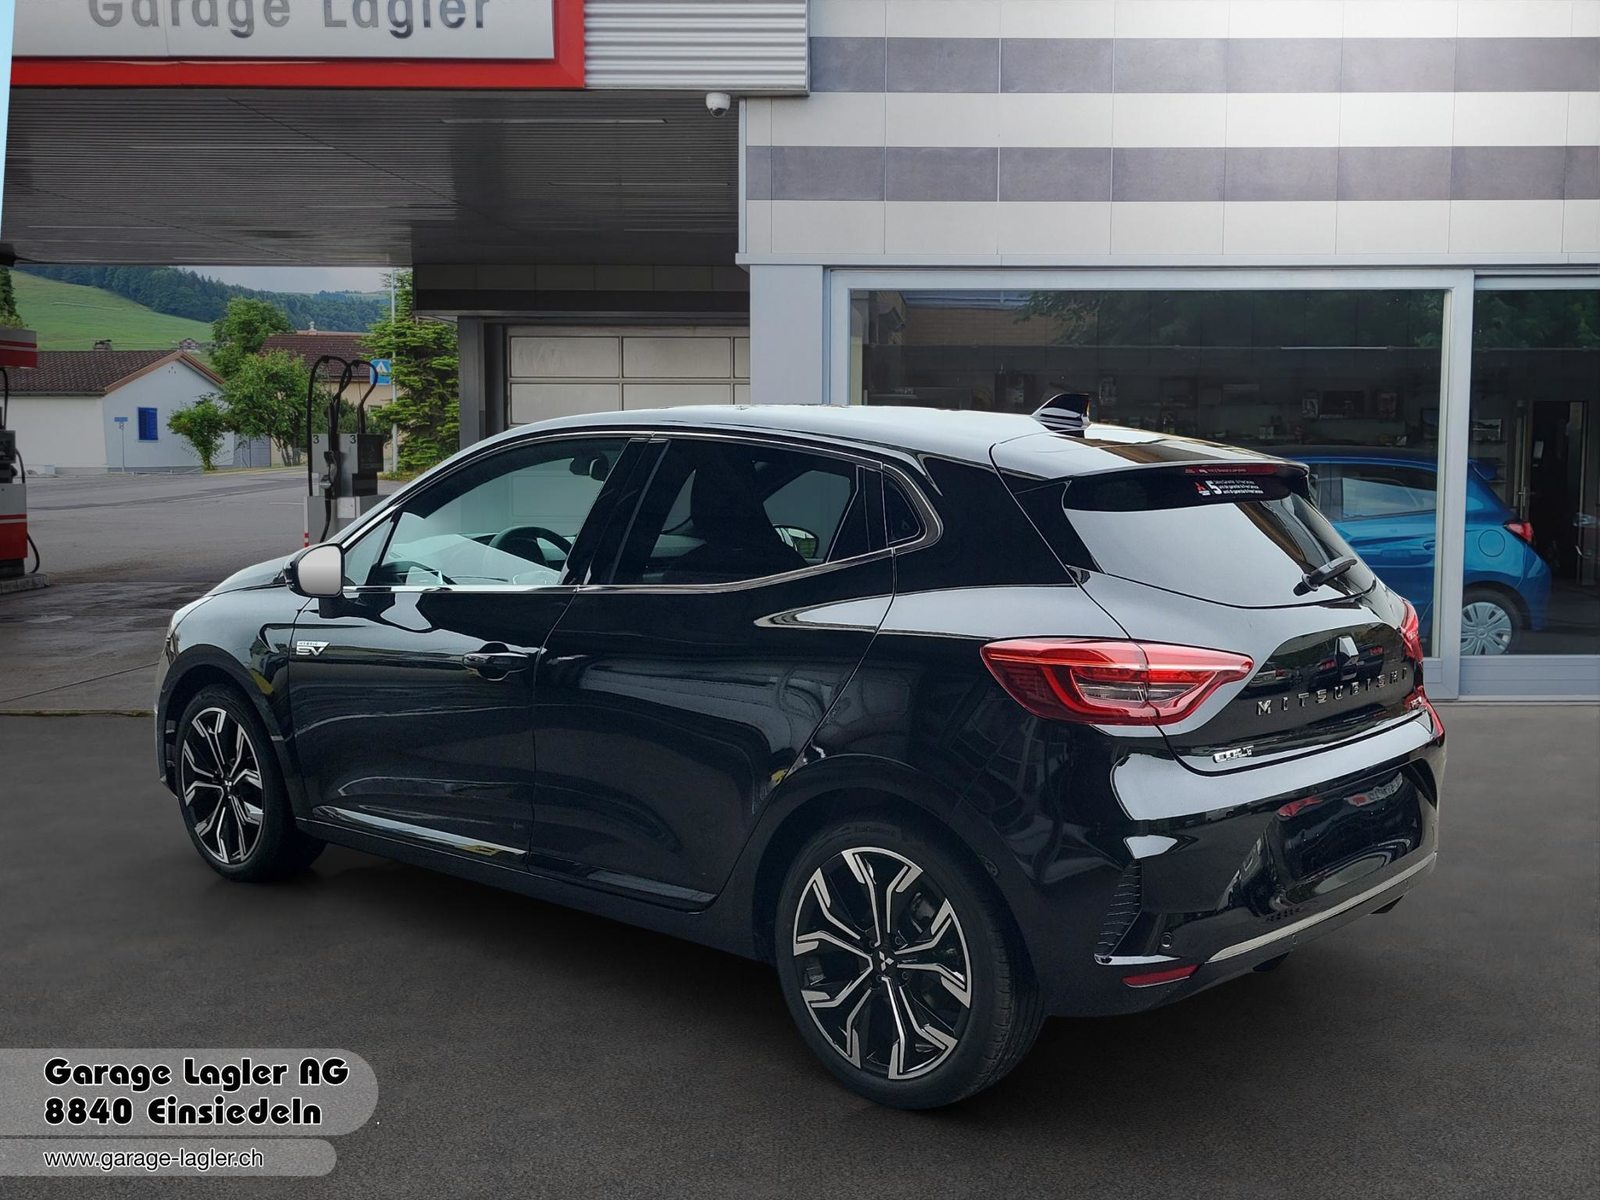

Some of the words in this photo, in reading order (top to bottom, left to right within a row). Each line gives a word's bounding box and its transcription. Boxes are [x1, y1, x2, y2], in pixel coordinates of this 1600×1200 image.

[312, 434, 320, 445] 3
[349, 434, 357, 445] 3
[1256, 667, 1408, 716] MITSUBISHI
